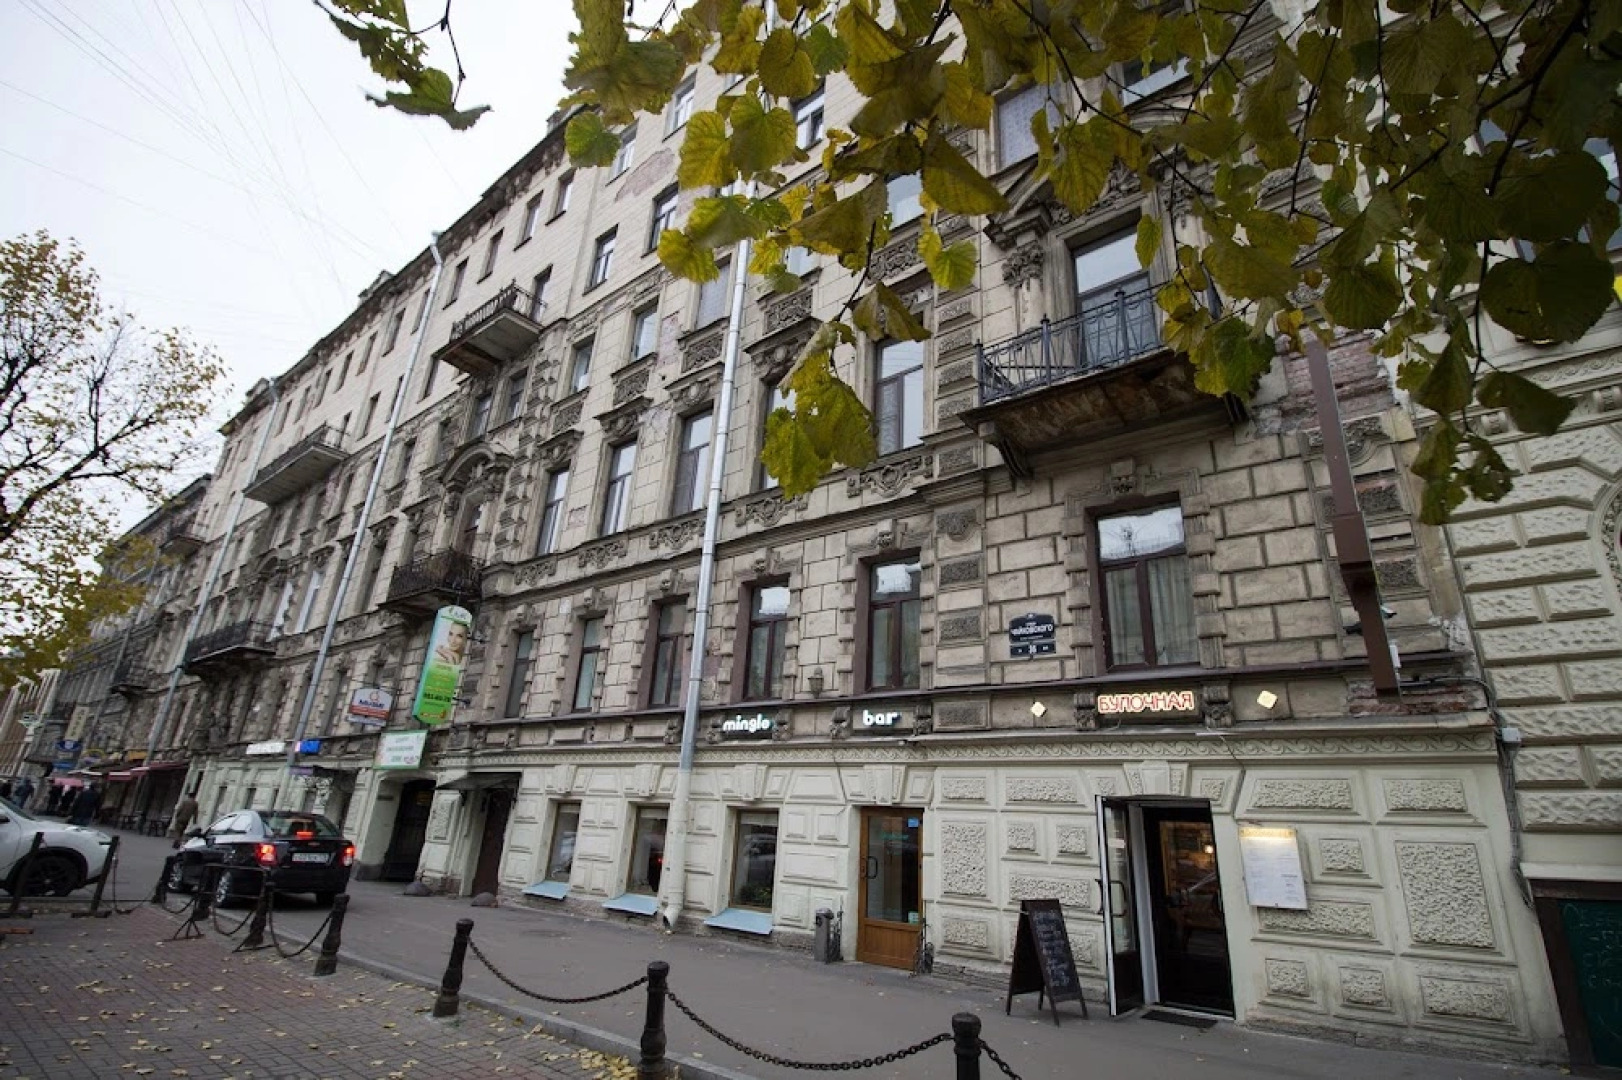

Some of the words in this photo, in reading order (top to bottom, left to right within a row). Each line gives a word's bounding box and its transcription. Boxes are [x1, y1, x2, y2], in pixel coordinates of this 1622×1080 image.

[1098, 691, 1194, 714] БУЛОЧНАЯ
[723, 713, 771, 733] mingle
[863, 710, 899, 726] bar
